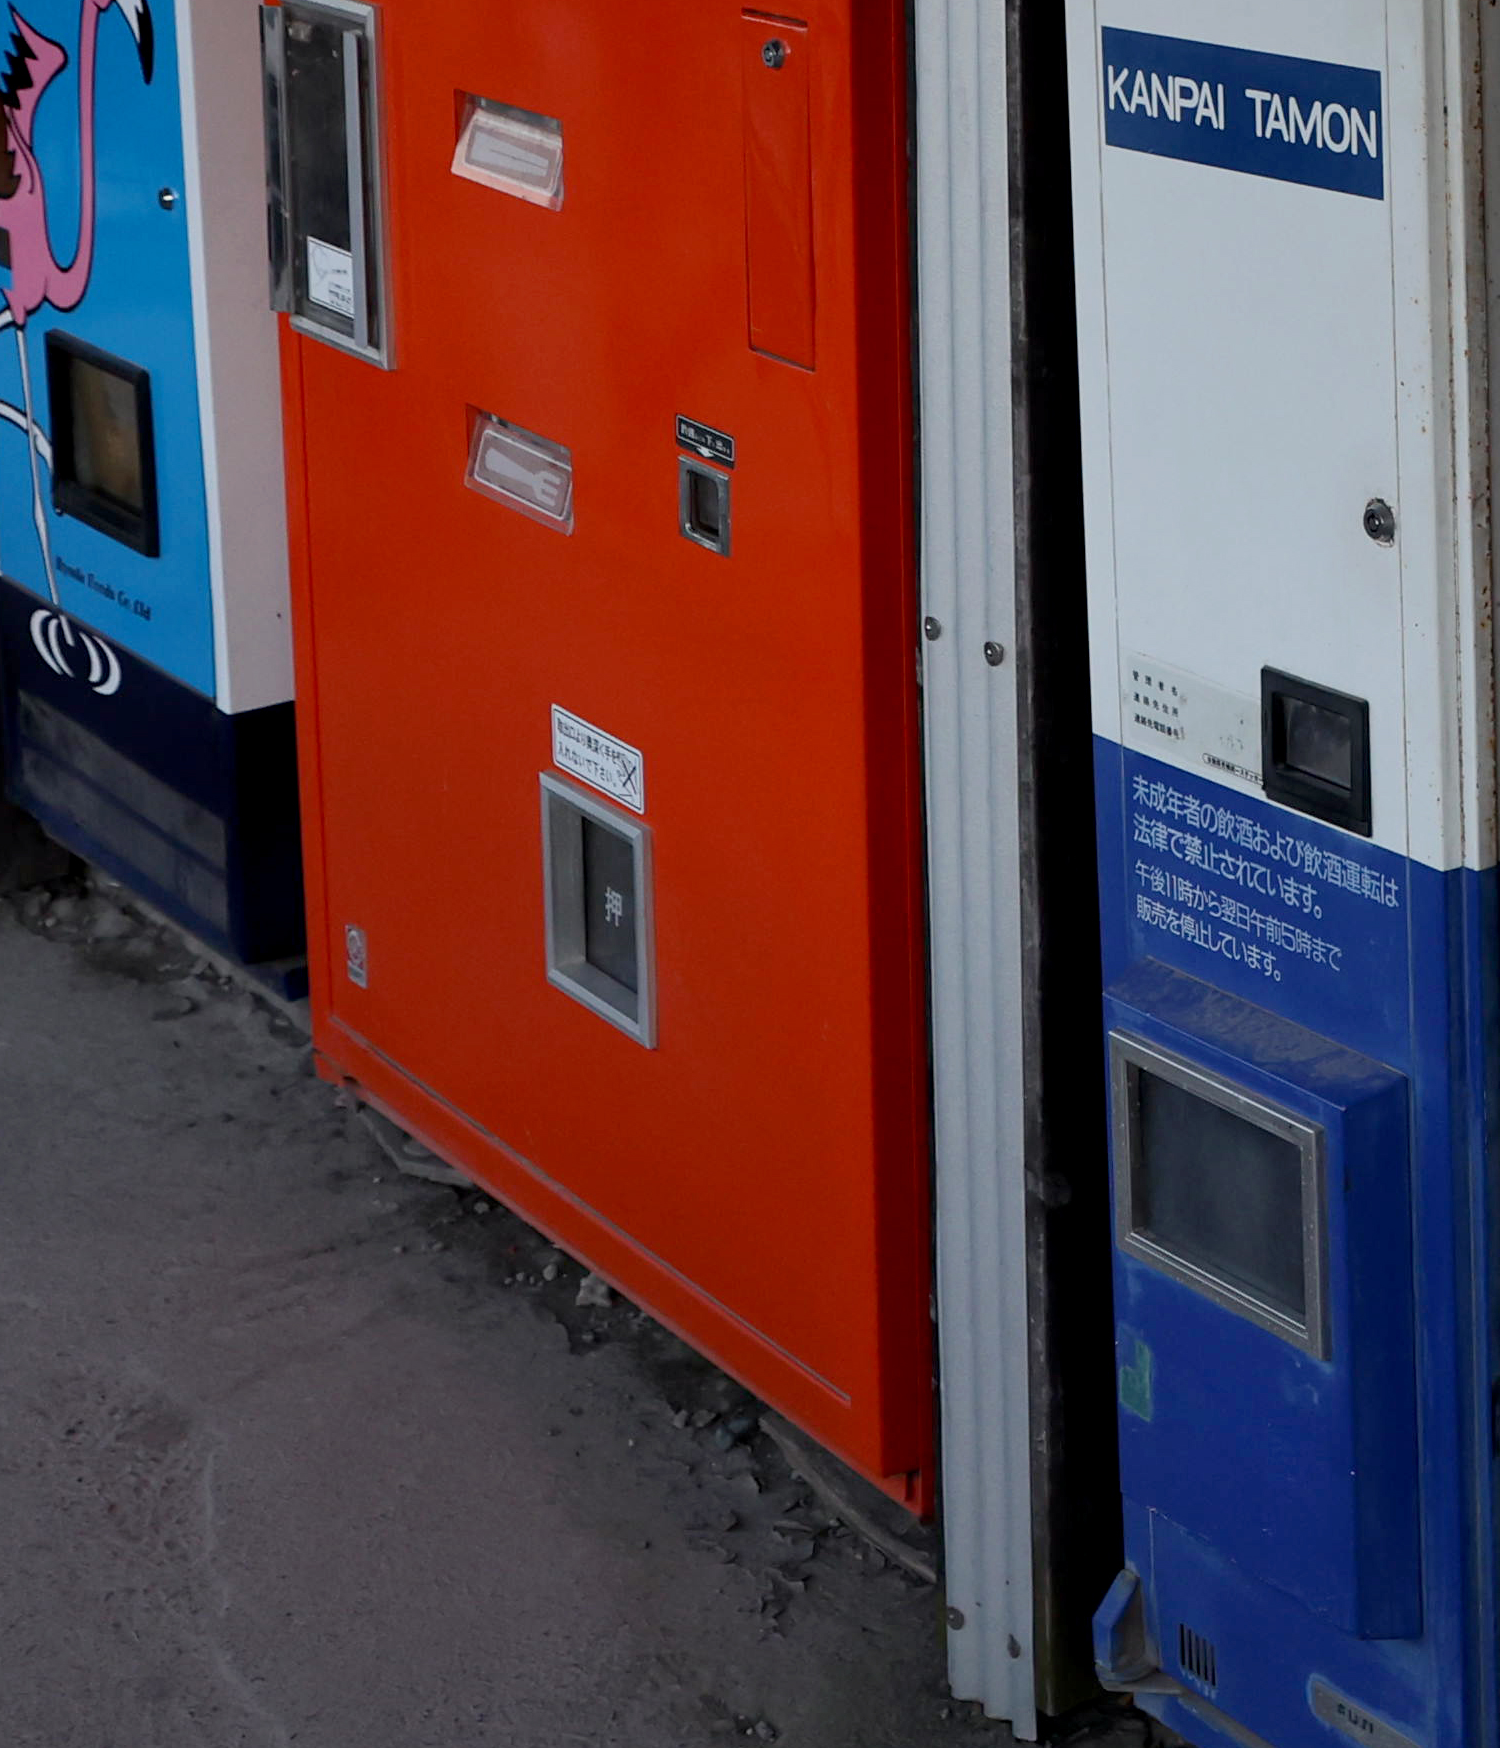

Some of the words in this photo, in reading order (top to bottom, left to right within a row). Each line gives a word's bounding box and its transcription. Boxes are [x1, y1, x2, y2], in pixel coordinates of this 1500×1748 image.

[1108, 65, 1224, 130] KANPAI
[1246, 89, 1376, 158] TAMON
[1133, 776, 1399, 909] 未成年者の飲酒および飲酒運転は
[1133, 814, 1323, 919] 法律で禁止されています。
[605, 885, 623, 927] 押
[1135, 862, 1342, 972] 午後11時から翌日午前5時まで
[1137, 895, 1282, 983] 販売を停止しています。
